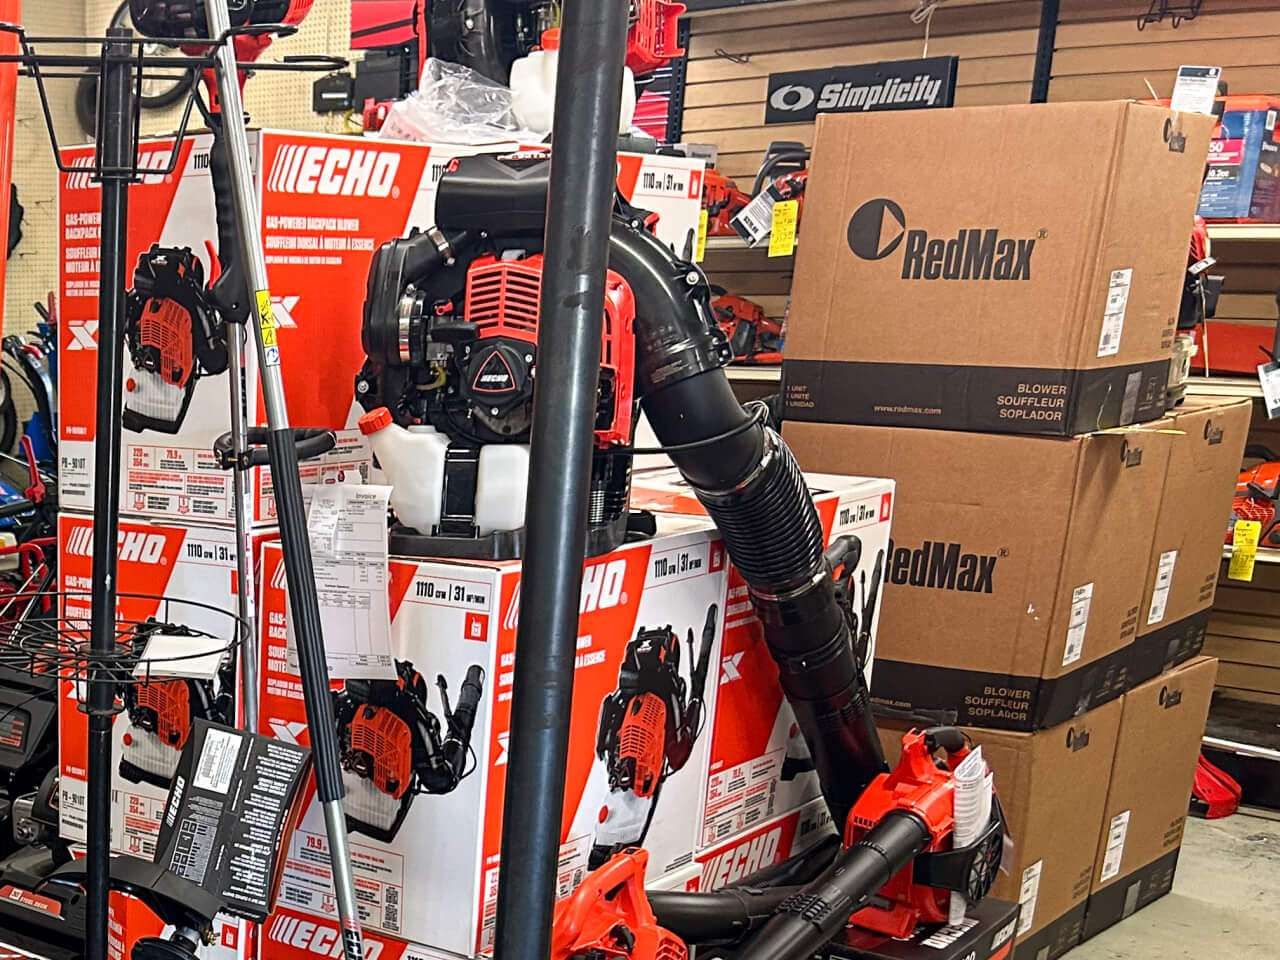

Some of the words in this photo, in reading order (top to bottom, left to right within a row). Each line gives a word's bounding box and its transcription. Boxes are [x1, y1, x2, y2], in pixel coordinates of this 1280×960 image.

[817, 74, 942, 109] Simplicity
[278, 145, 400, 198] ECHO
[901, 228, 1038, 281] RedMax
[1017, 383, 1067, 395] BLOWER
[996, 395, 1065, 408] SOUFFLEUR
[999, 408, 1063, 421] SOPLADOR
[187, 543, 203, 559] 1110
[219, 546, 228, 561] 31
[416, 580, 434, 597] 1110
[455, 586, 465, 602] 31
[984, 686, 1031, 699] BLOWER
[964, 696, 1029, 710] SOUFFLEUR
[968, 707, 1027, 721] SOPLADOR
[168, 776, 186, 821] ECHO
[710, 826, 781, 887] ECHO
